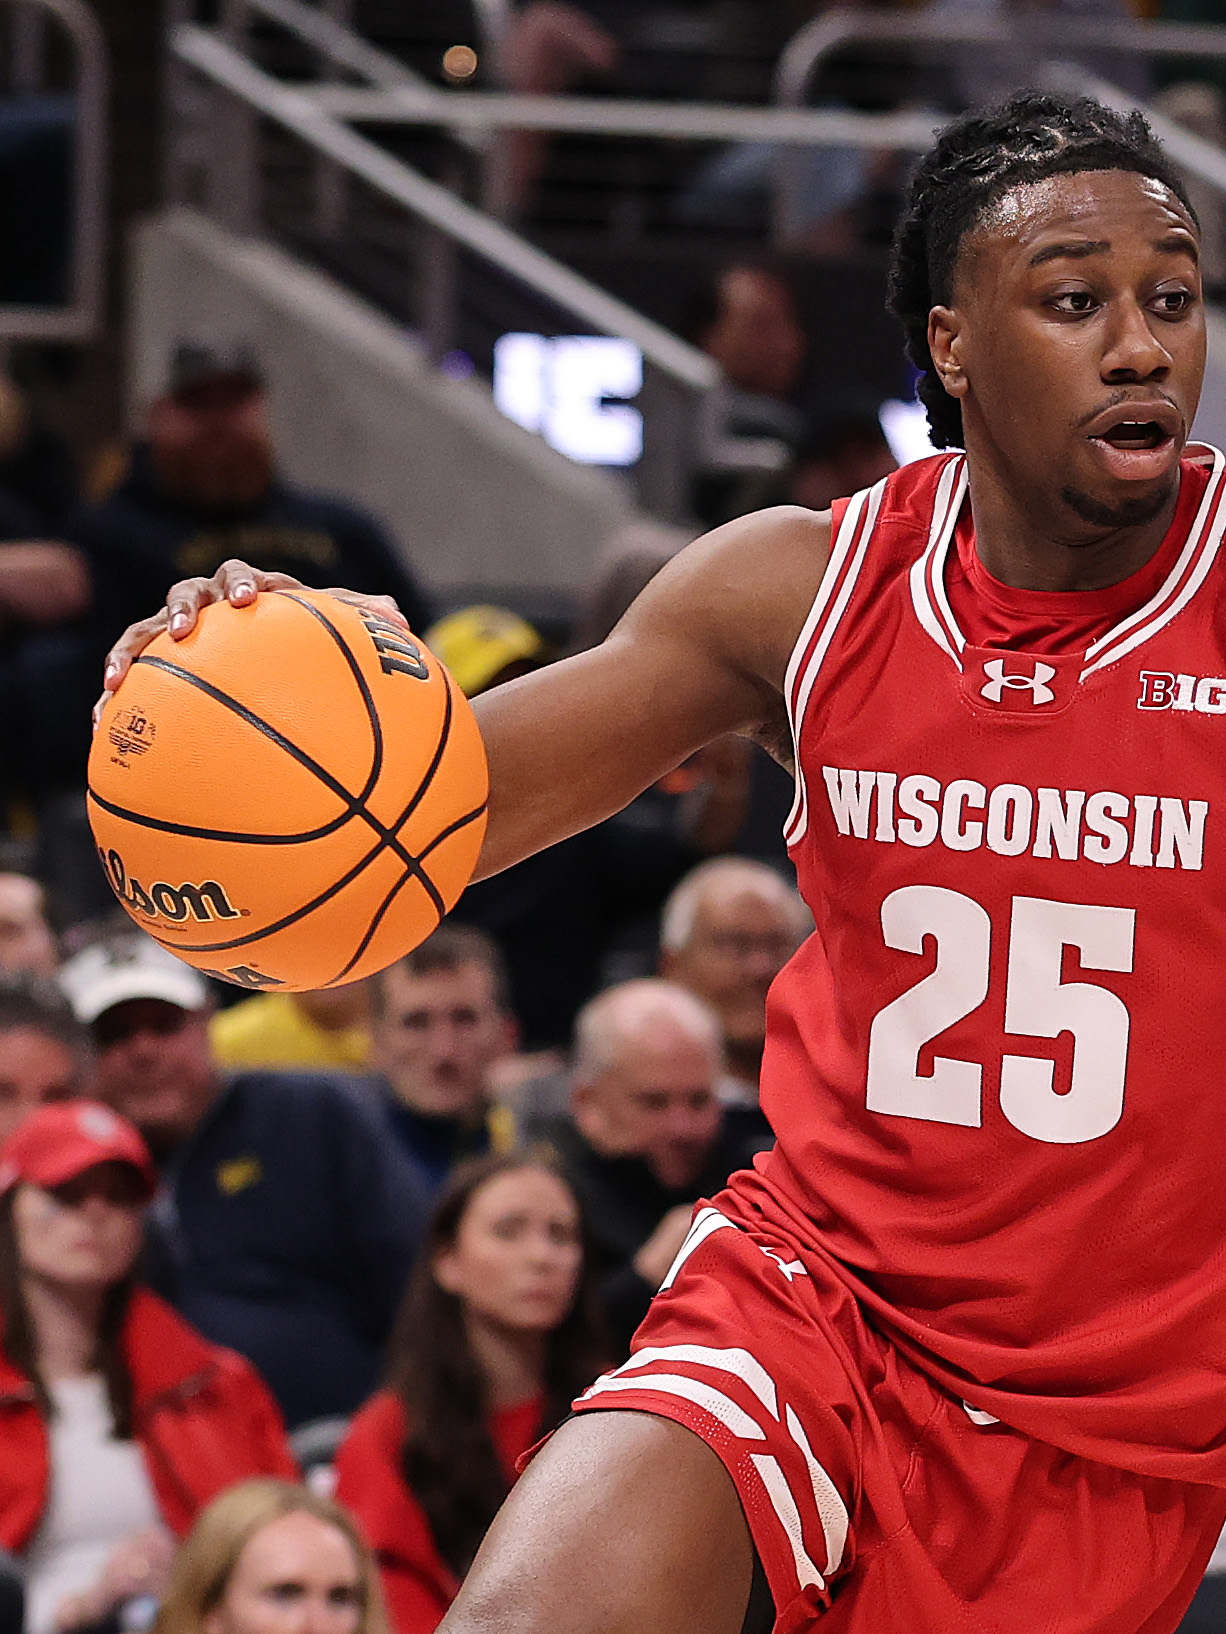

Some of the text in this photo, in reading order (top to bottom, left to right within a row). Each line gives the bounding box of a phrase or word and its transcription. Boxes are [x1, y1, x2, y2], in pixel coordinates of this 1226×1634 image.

[821, 765, 1208, 871] WISCONSIN
[100, 847, 242, 923] lson
[865, 884, 1136, 1144] 25
